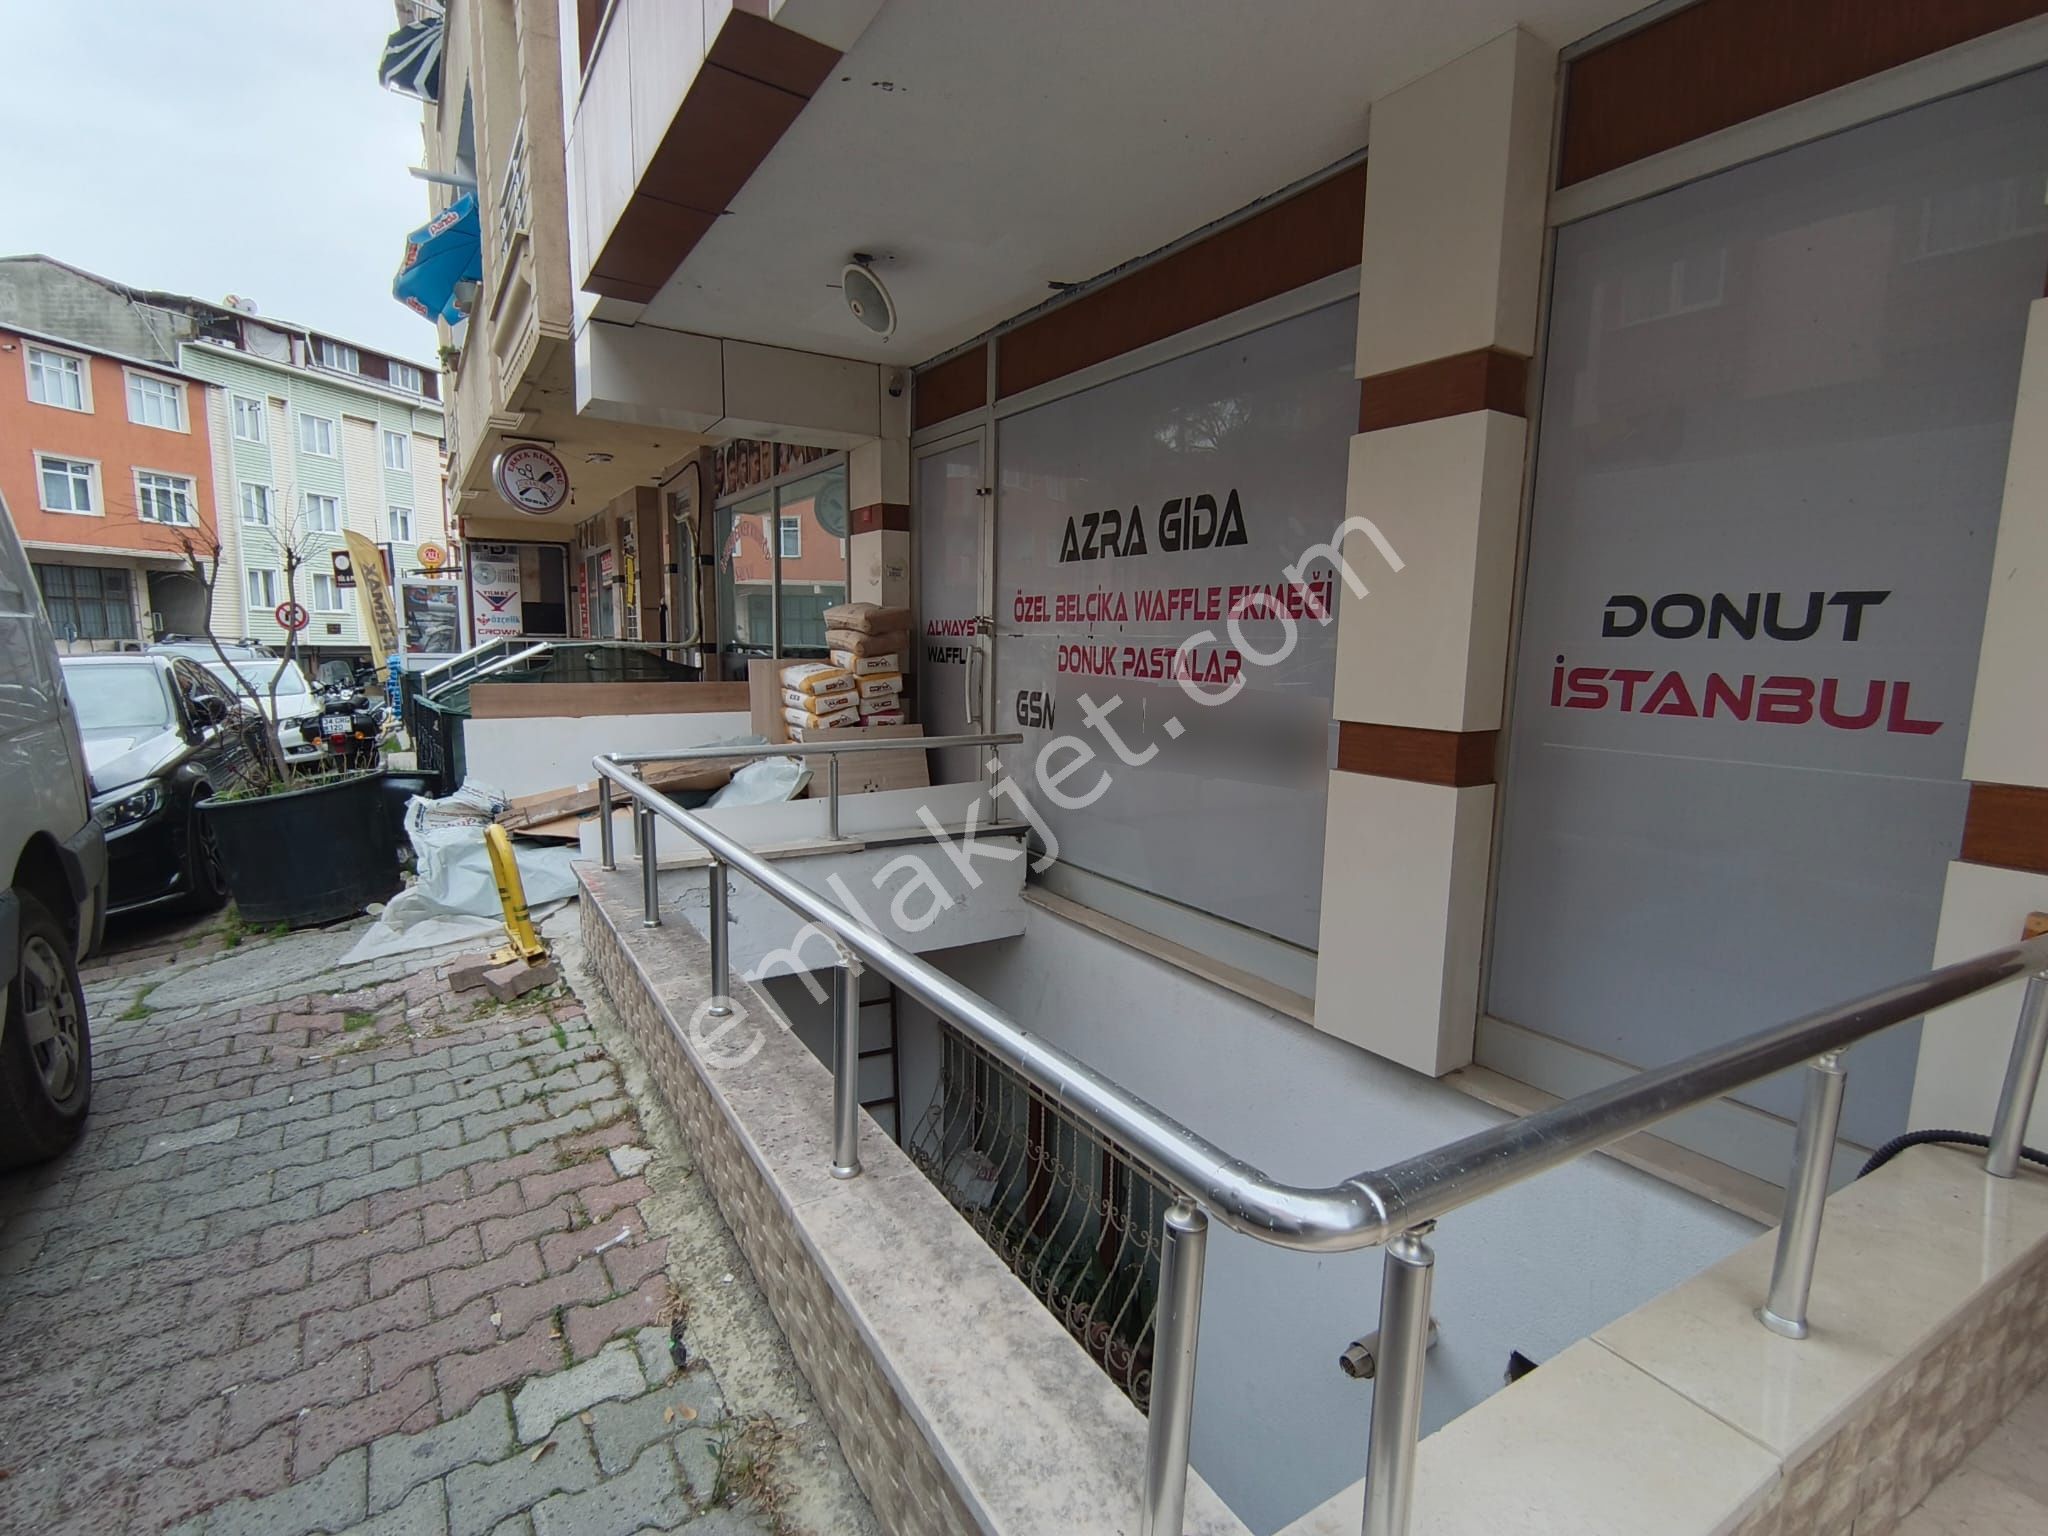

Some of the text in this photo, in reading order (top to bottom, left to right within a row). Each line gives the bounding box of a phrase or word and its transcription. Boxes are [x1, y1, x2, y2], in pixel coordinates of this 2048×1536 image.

[1059, 488, 1248, 563] AZRA GIDA
[1014, 569, 1333, 632] ÖZEL BELÇİKA WAFFLE EKMEĞİ
[1601, 590, 1893, 642] DONUT
[927, 619, 976, 637] ALWAYS
[927, 645, 974, 665] WAFFL
[1058, 644, 1242, 685] DONUK PASTALAR
[1550, 654, 1944, 736] İSTANBUL
